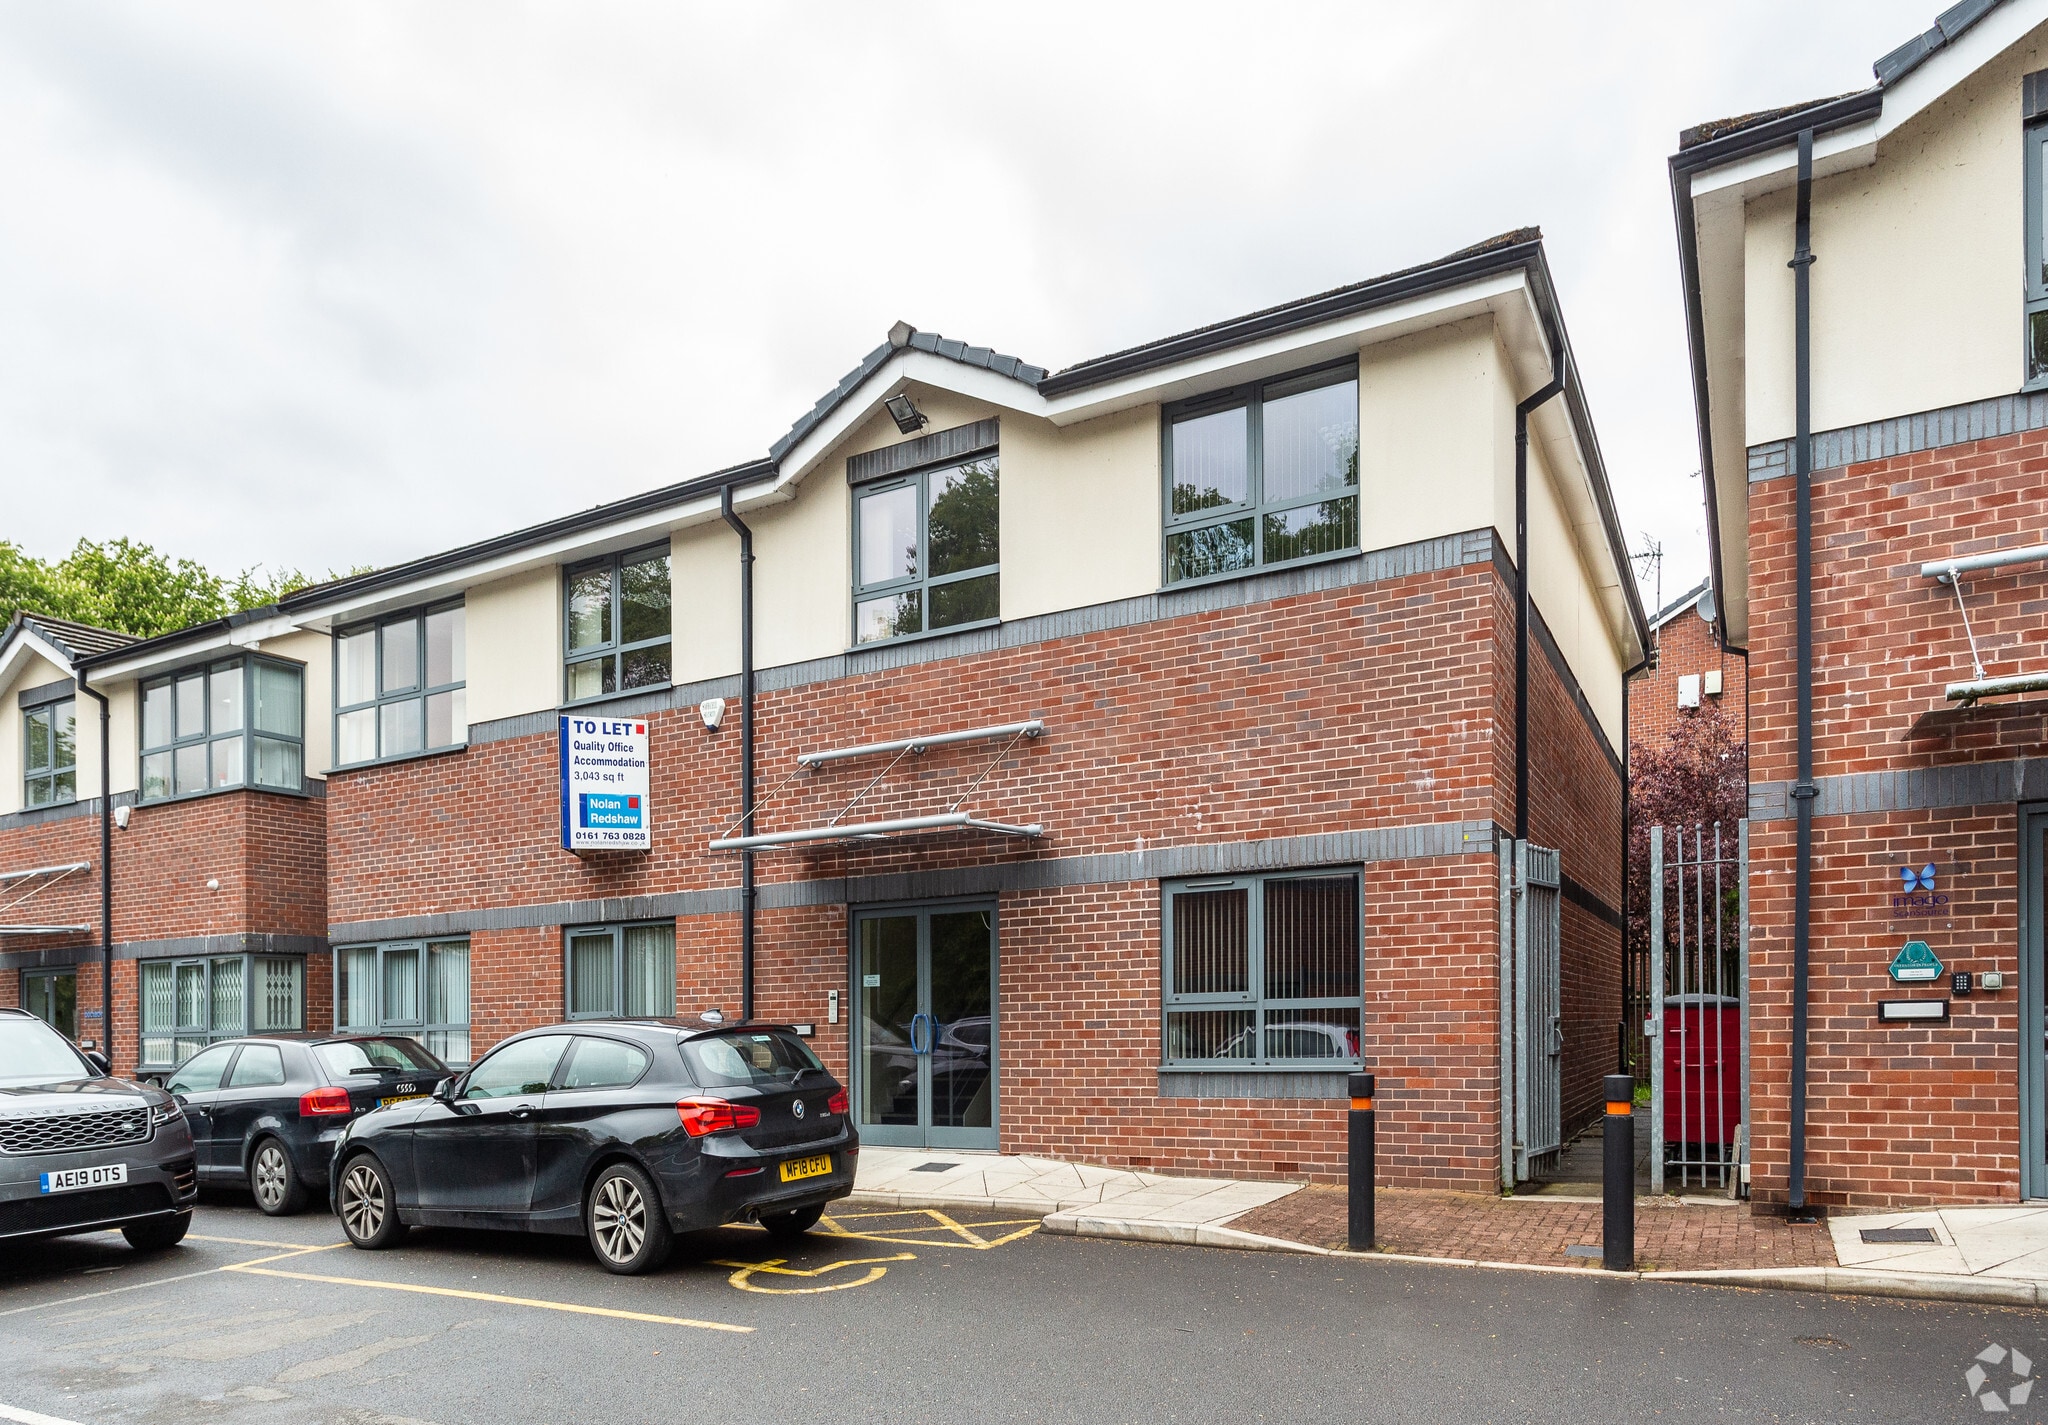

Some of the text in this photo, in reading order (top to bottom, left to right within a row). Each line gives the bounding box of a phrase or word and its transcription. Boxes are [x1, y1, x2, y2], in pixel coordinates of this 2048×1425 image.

[573, 720, 632, 736] TO LET
[573, 740, 634, 753] Quality Office
[573, 755, 645, 768] Accommodation
[574, 771, 625, 783] 3,043 sq ft
[590, 798, 639, 824] Nolan Redshaw
[575, 831, 646, 841] 0161 763 0828
[1893, 894, 1949, 909] imago
[1893, 909, 1949, 918] ScanSource
[786, 1156, 827, 1177] MF18 CFU
[55, 1167, 120, 1188] AE19 OTS
